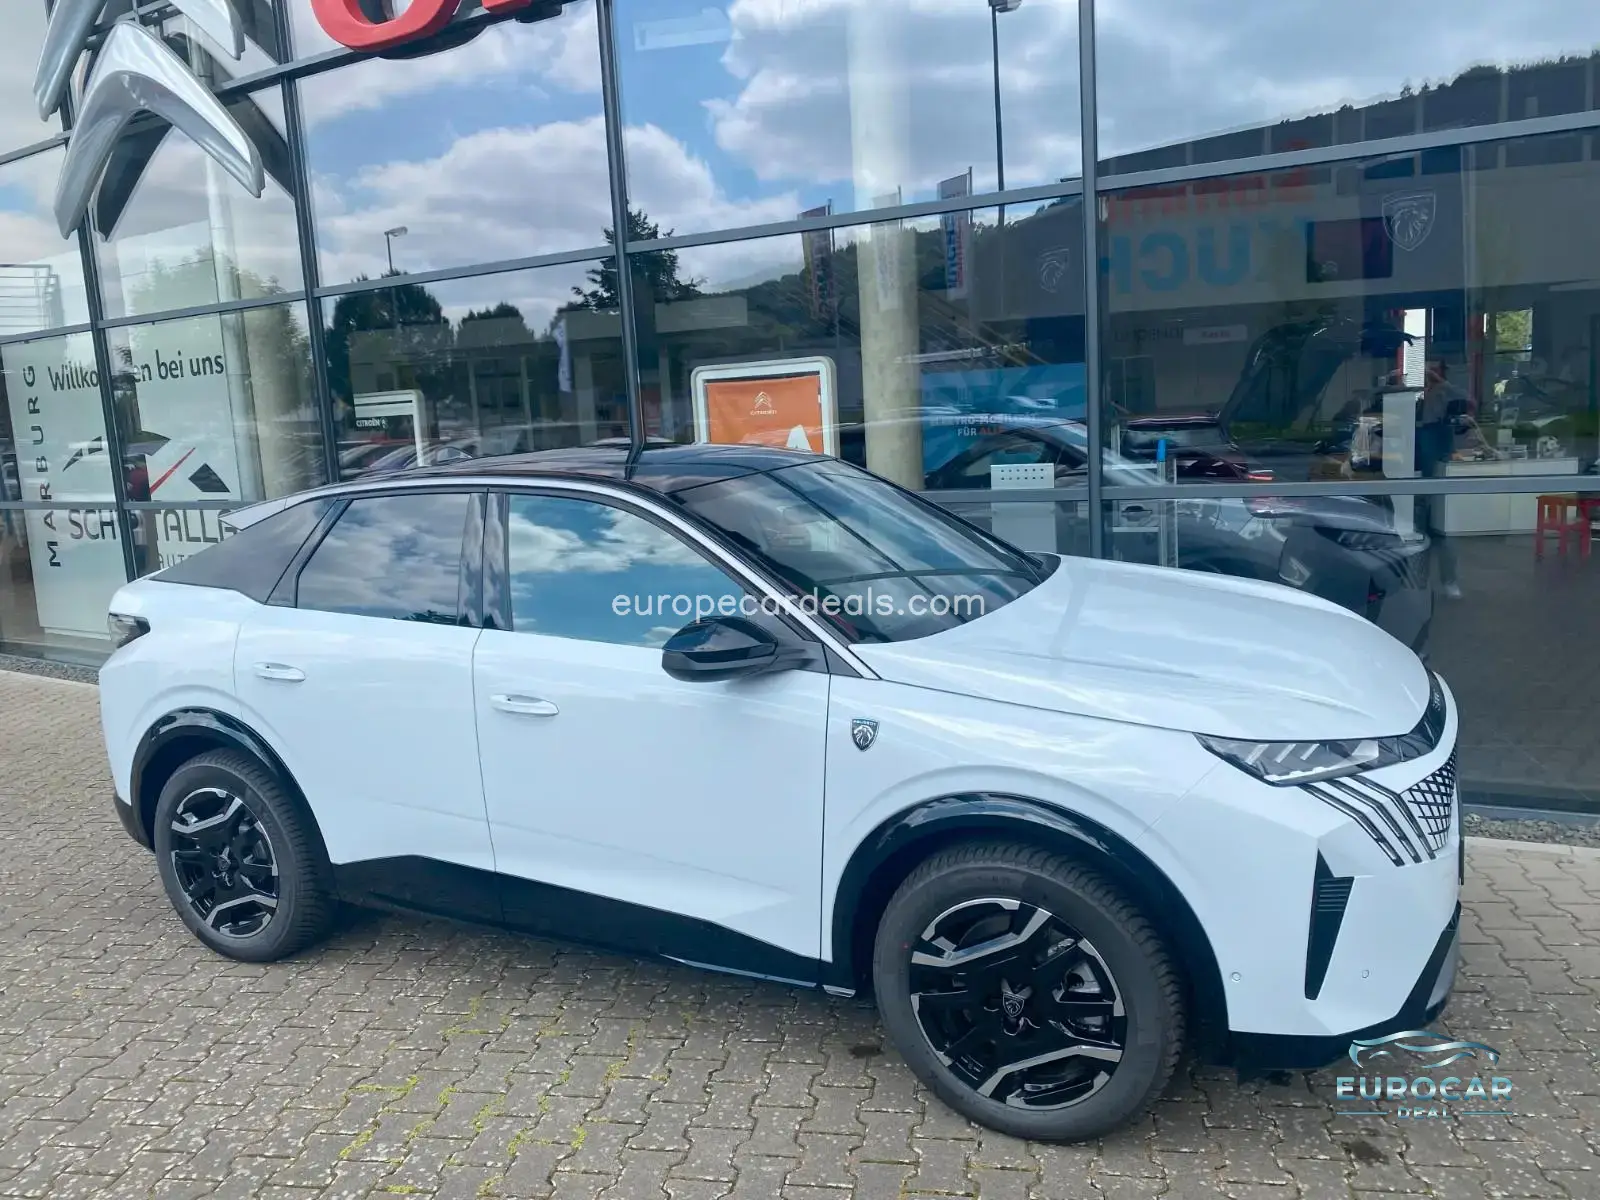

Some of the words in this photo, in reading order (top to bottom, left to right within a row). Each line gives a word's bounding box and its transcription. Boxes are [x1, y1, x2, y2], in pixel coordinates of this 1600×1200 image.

[48, 357, 152, 391] Willkoen
[156, 349, 184, 381] bei
[190, 354, 224, 377] uns
[356, 417, 380, 428] CITROËN
[957, 426, 977, 437] FÜR
[23, 365, 61, 567] MARBURG
